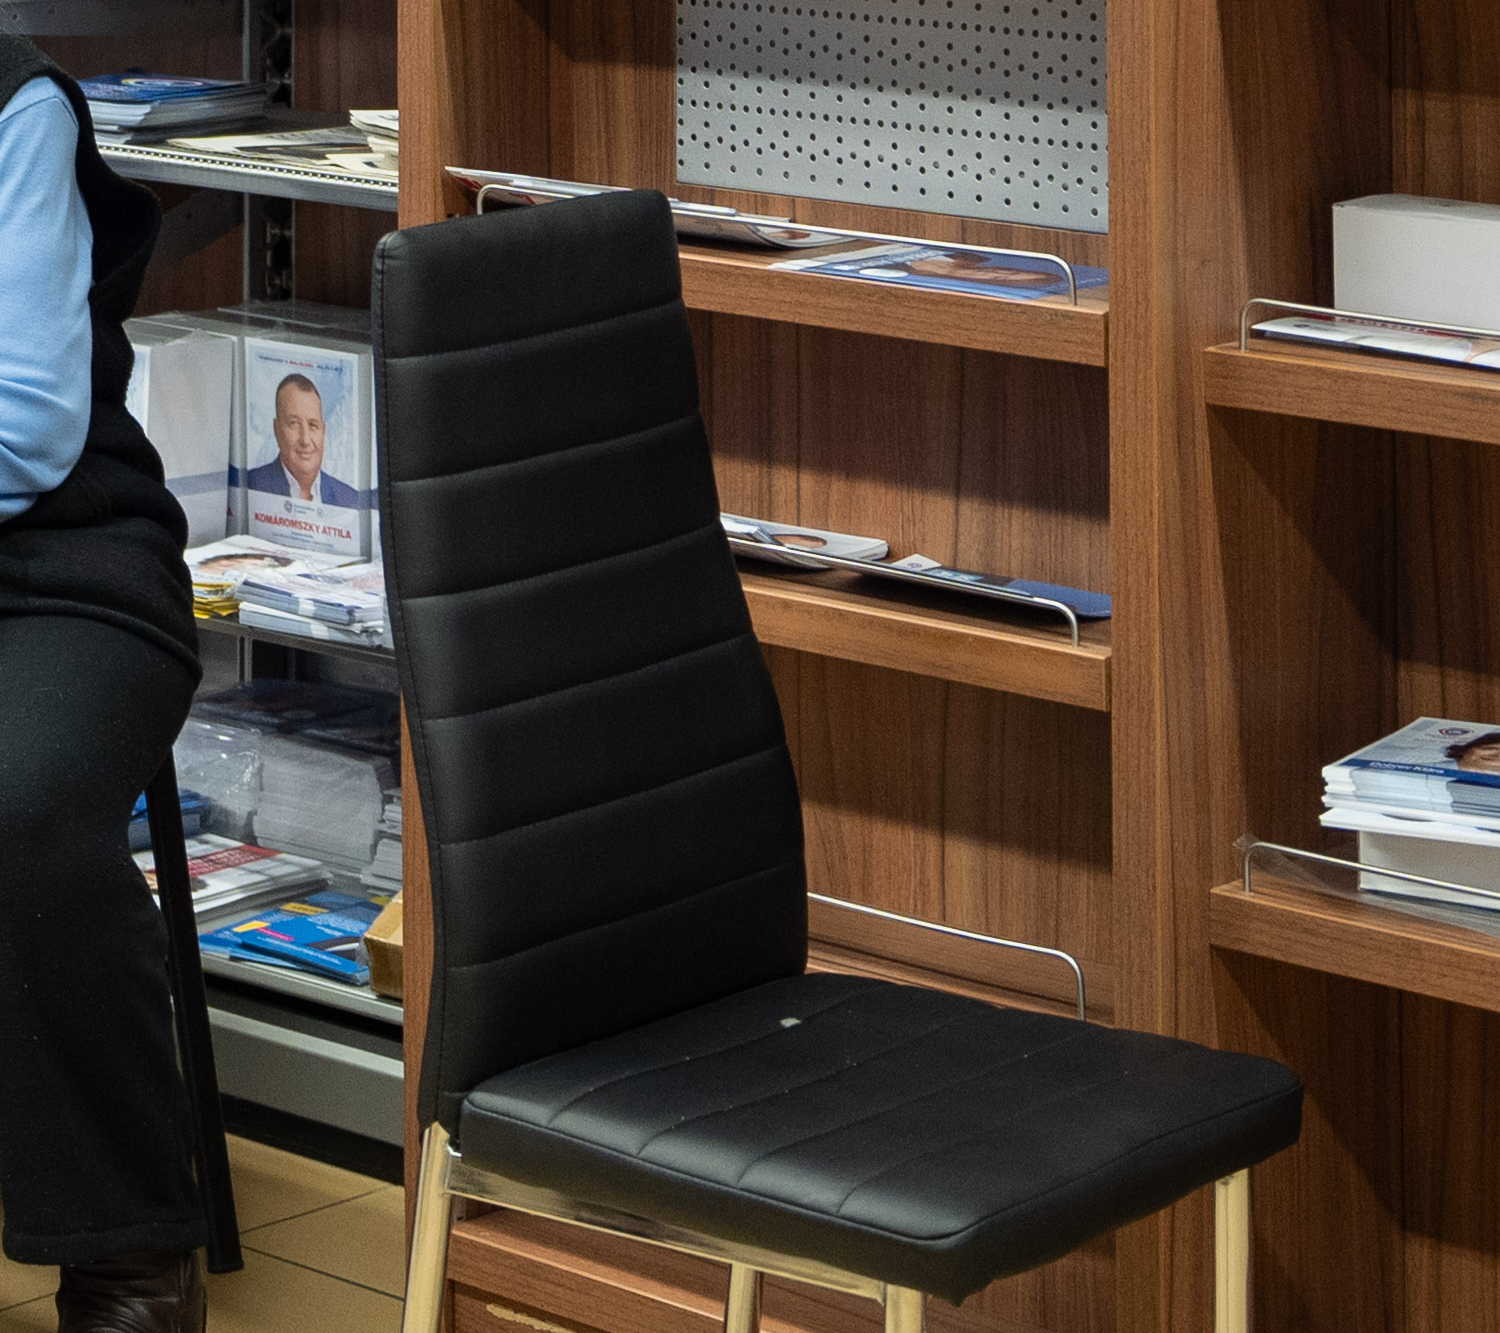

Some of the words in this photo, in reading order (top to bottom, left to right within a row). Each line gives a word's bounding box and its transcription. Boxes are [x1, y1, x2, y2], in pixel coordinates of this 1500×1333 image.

[254, 511, 320, 535] KOMÁROMSZKY
[321, 527, 352, 540] ATTILA
[1369, 761, 1413, 772] Dobrev
